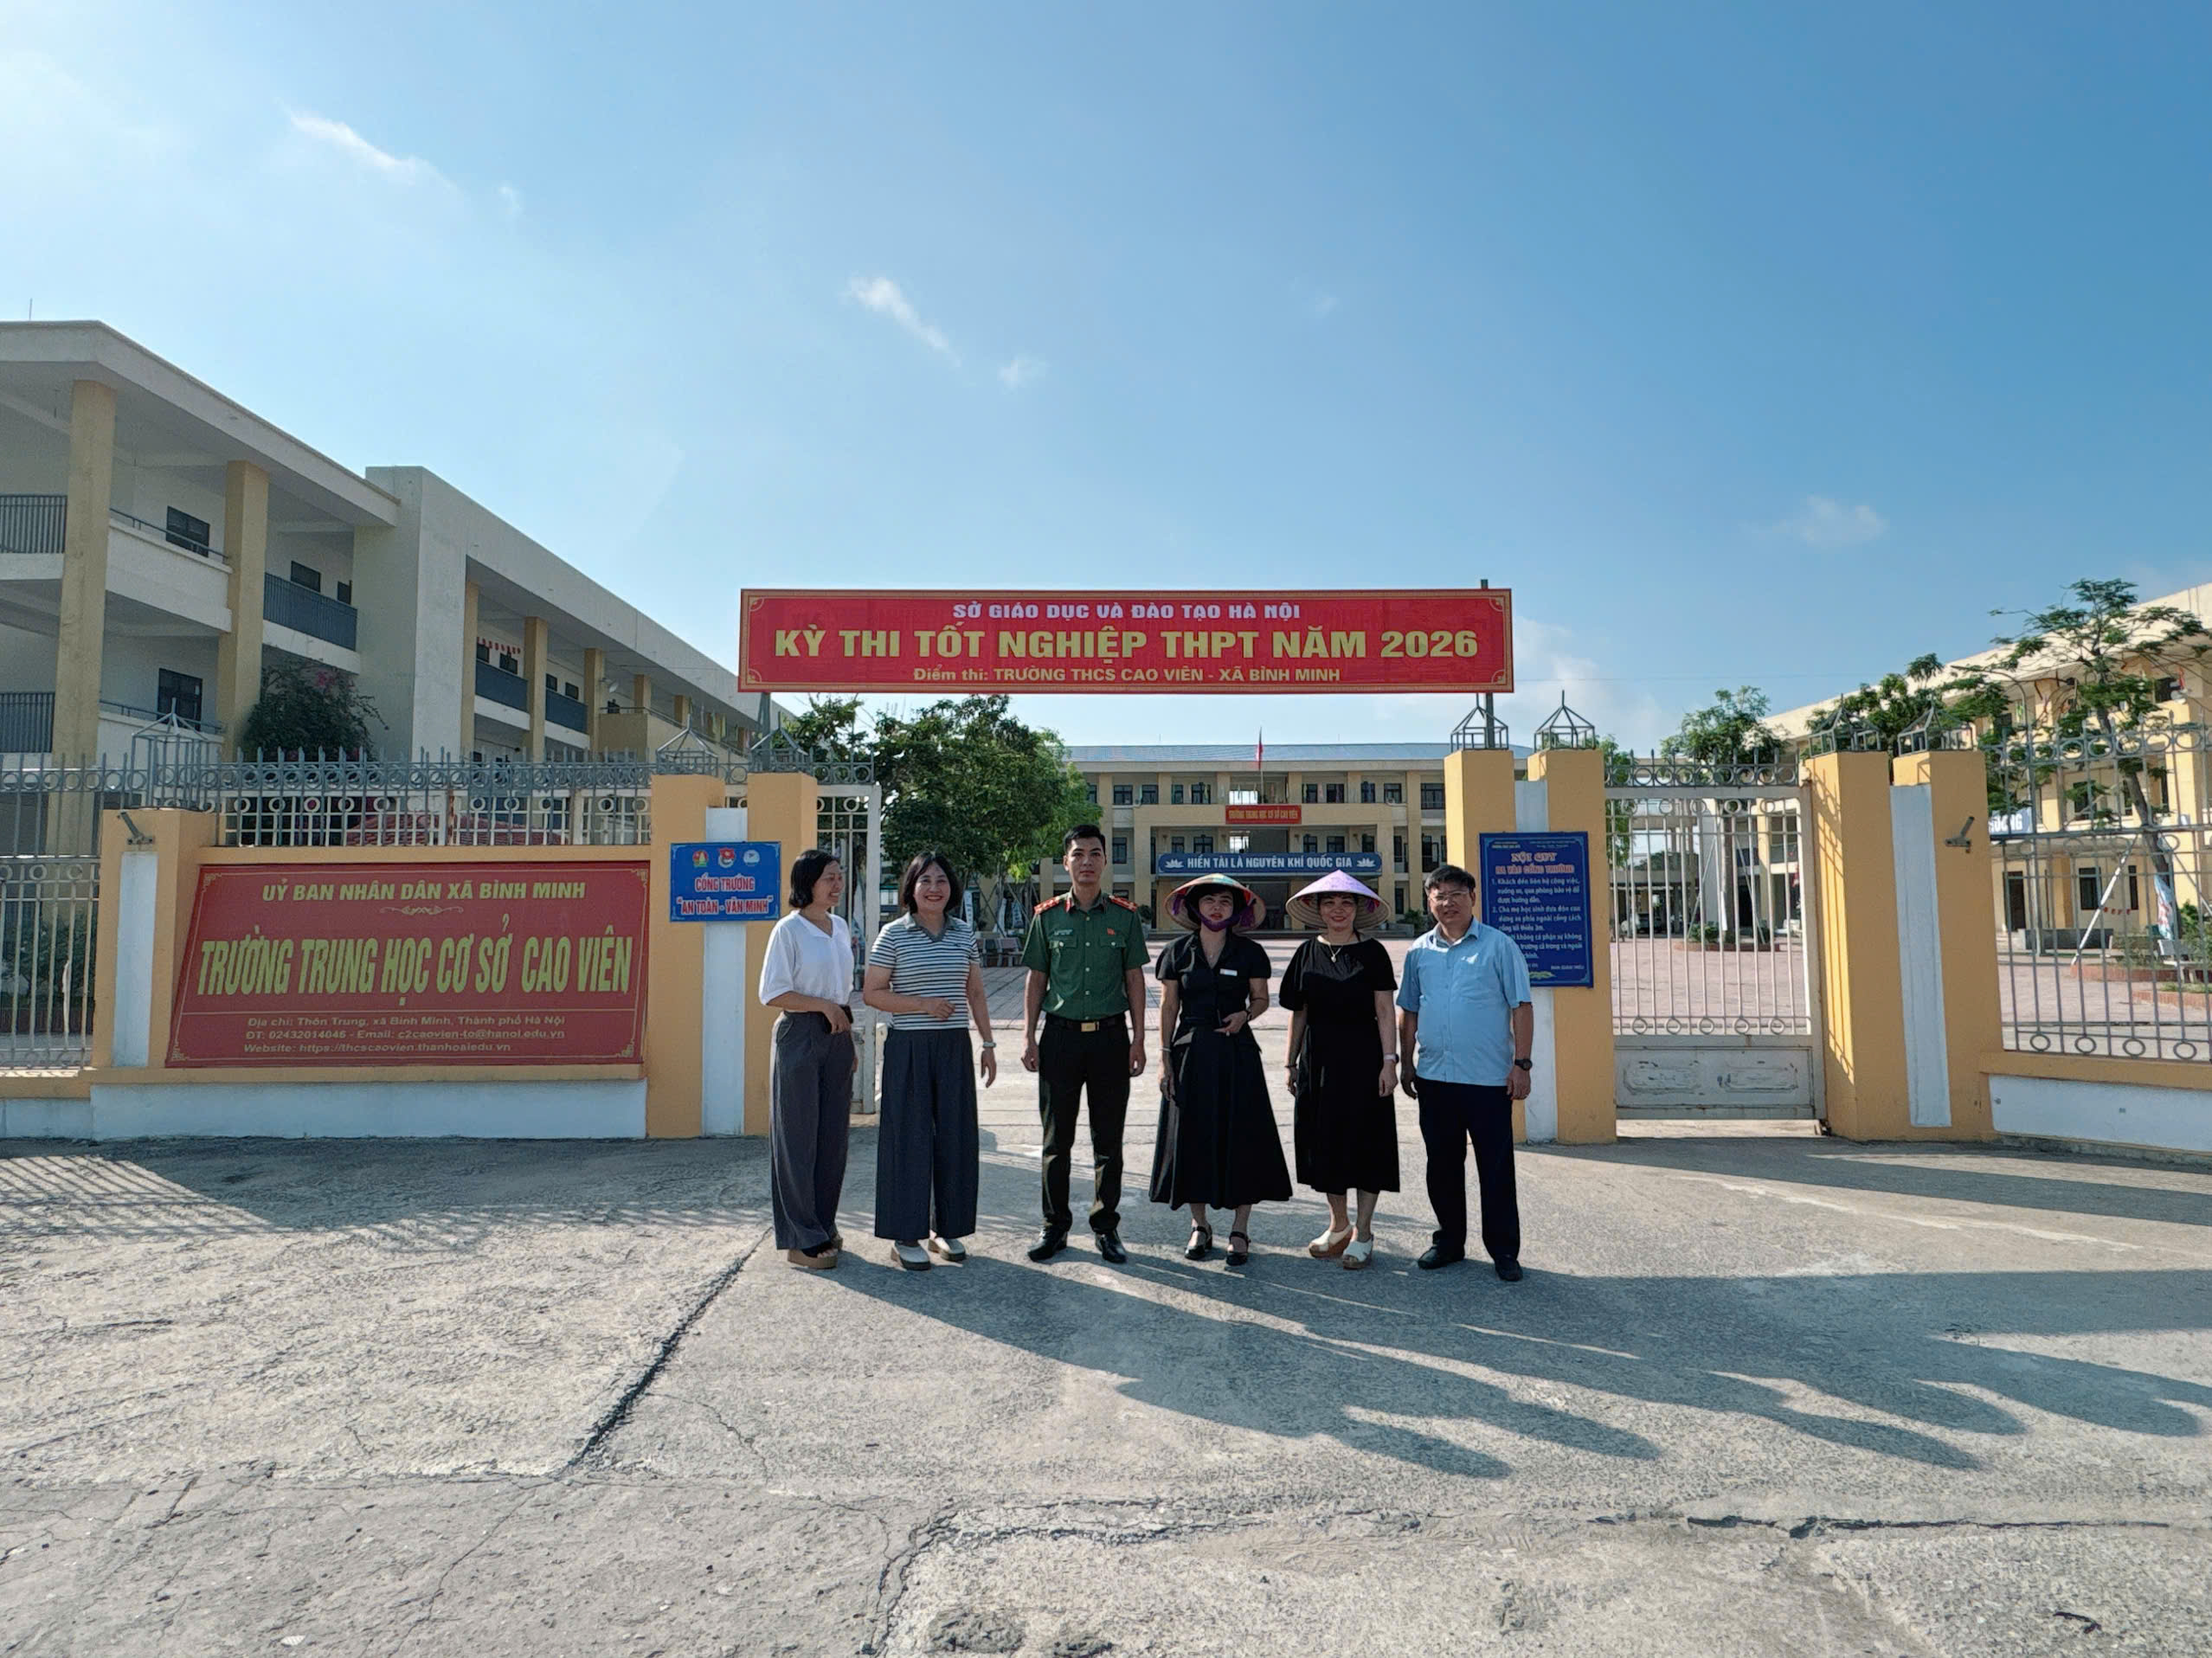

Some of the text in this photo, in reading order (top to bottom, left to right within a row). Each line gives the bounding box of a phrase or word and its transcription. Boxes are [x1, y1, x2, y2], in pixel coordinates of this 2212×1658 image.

[954, 601, 1300, 621] SỞ GIÁO DỤC VÀ ĐÀO TẠO HÀ NỘI
[775, 621, 1478, 665] KỲ THI TỐT NGHIỆP THPT NĂM 2026
[913, 664, 956, 681] Điểm
[961, 668, 988, 681] thi:
[993, 665, 1065, 681] TRƯỜNG
[1071, 668, 1116, 681] THCS
[1120, 668, 1159, 681] CAO
[1163, 665, 1204, 681] VIÊN
[1219, 665, 1244, 681] XÃ
[1250, 665, 1290, 681] BÌNH
[1295, 668, 1341, 681] MINH
[1213, 856, 1228, 869] TÀI
[1231, 856, 1244, 869] LÀ
[1246, 855, 1284, 869] NGUYÊN
[1288, 855, 1304, 868] KHÍ
[1307, 853, 1333, 869] QUỐC
[1335, 857, 1353, 867] GIA
[1511, 851, 1532, 864] NỘI
[293, 884, 334, 901] BAN
[339, 879, 395, 900] NHÂN
[400, 879, 442, 900] DÂN
[447, 879, 474, 900] XÃ
[479, 879, 527, 899] BÌNH
[532, 882, 587, 899] MINH
[695, 896, 720, 915] TOÀN
[725, 896, 744, 914] VĂN
[197, 913, 633, 1006] TRƯỜNG TRUNG HỌC CƠ SỞ CAO VIÊN
[457, 1016, 495, 1026] Thành
[524, 1016, 542, 1025] Hà
[543, 1016, 565, 1026] Nội
